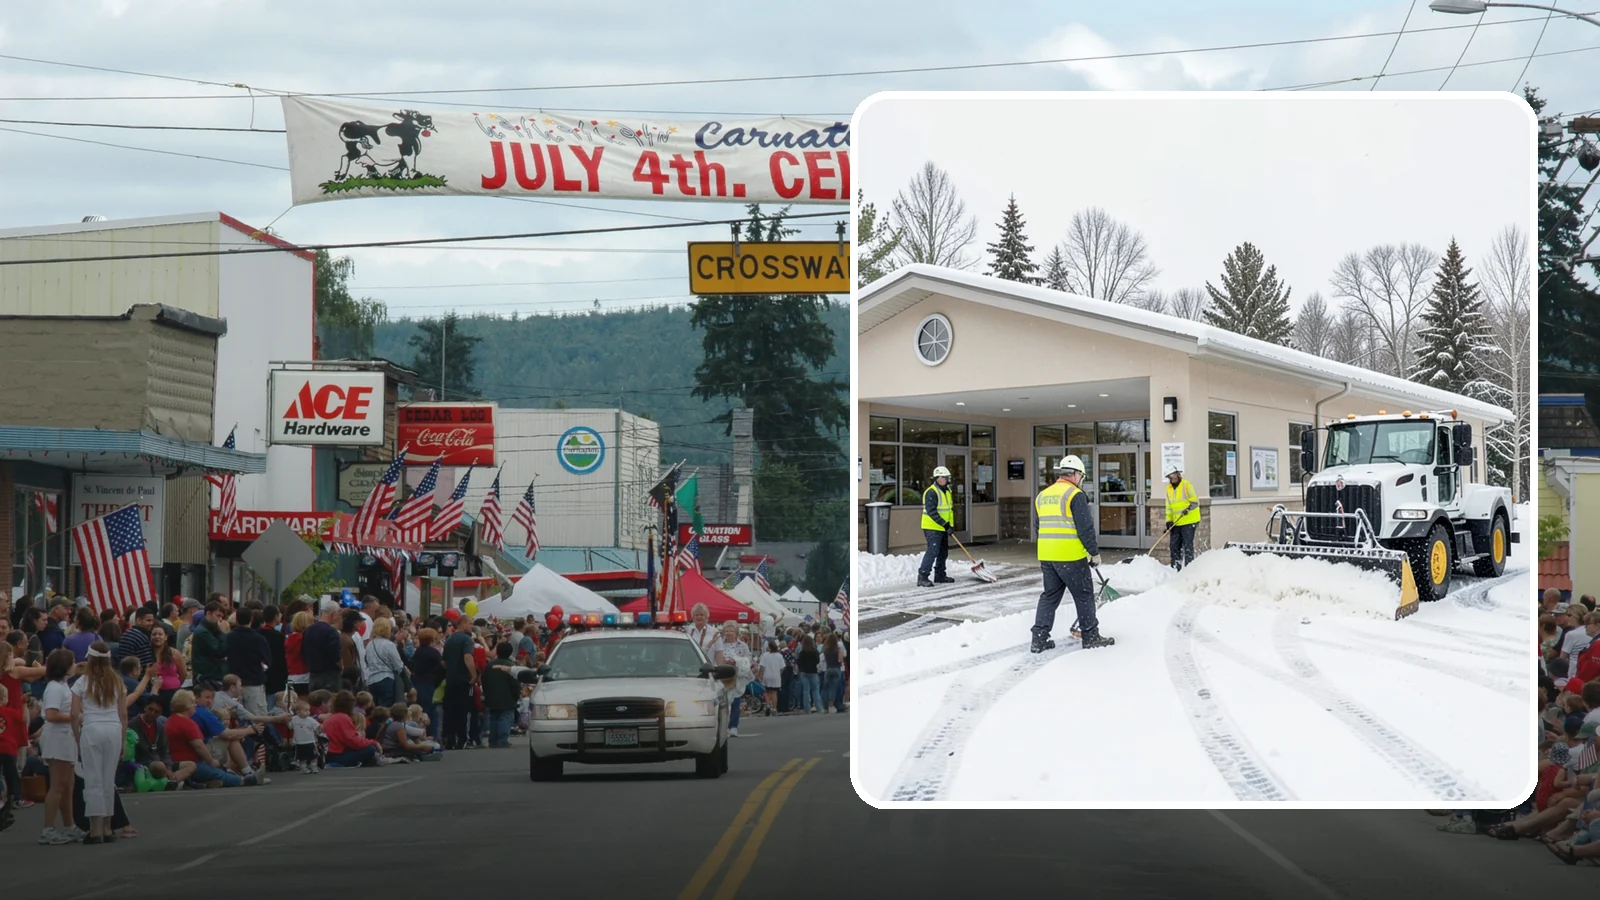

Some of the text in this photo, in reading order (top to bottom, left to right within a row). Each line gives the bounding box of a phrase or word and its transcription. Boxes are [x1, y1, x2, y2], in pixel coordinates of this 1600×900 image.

[482, 141, 605, 192] JULY
[632, 150, 746, 198] 4th.
[697, 254, 850, 280] CROSSWA
[283, 380, 373, 420] ACE
[405, 409, 452, 422] CEDAR
[283, 421, 370, 437] Hardware
[417, 428, 477, 447] Coca-Cola
[354, 467, 383, 481] Simpl
[96, 485, 124, 495] Vincent
[126, 485, 136, 495] de
[138, 486, 155, 496] Paul
[688, 526, 741, 535] CRNATION
[699, 535, 730, 543] GLASS
